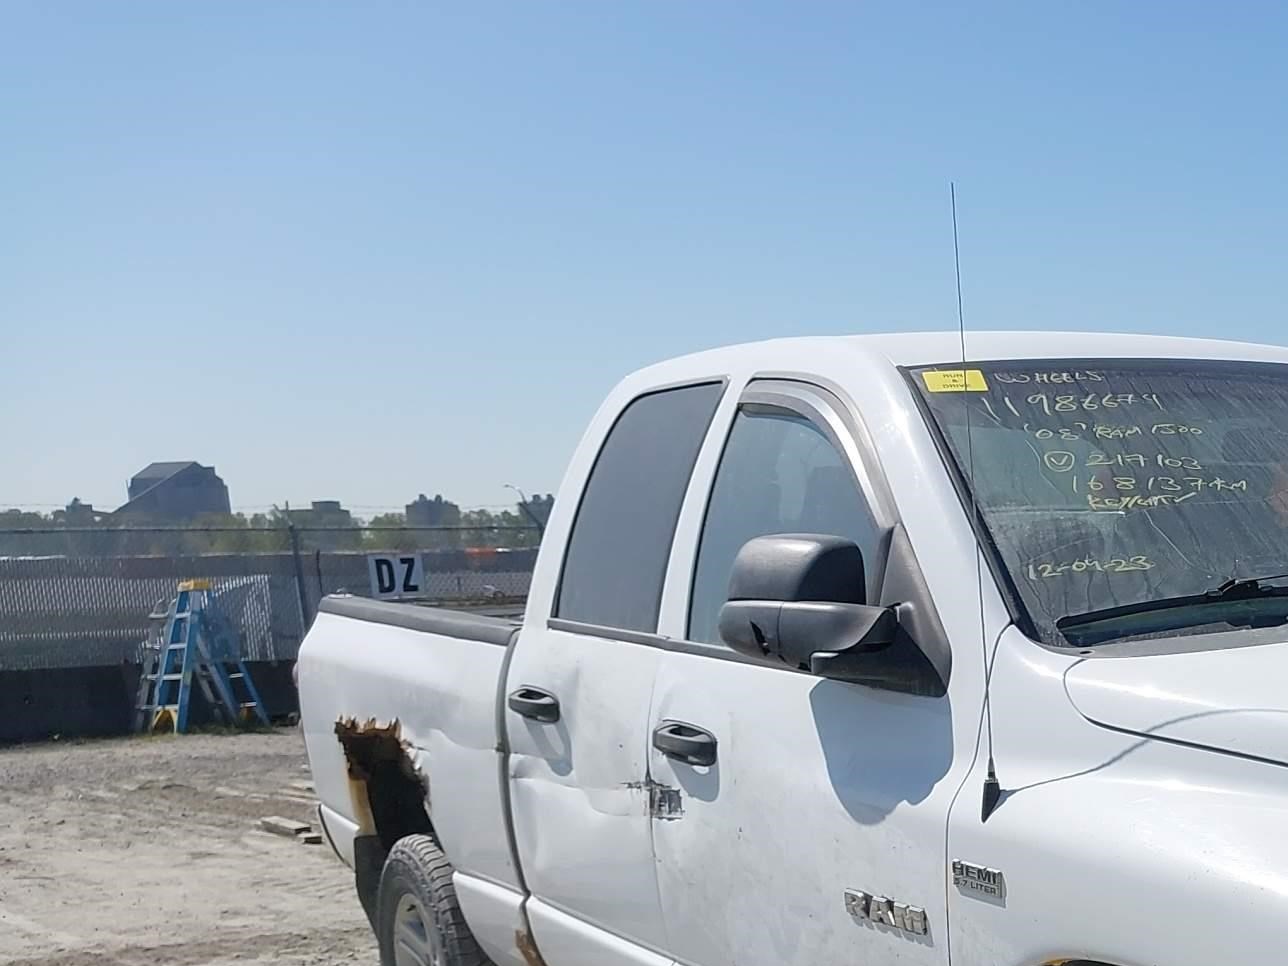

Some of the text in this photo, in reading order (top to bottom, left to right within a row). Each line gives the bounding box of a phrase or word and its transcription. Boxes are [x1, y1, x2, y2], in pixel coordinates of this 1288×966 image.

[374, 558, 419, 593] DZ
[952, 861, 999, 885] HEMI
[970, 881, 998, 895] LITER
[844, 888, 927, 936] RAM
